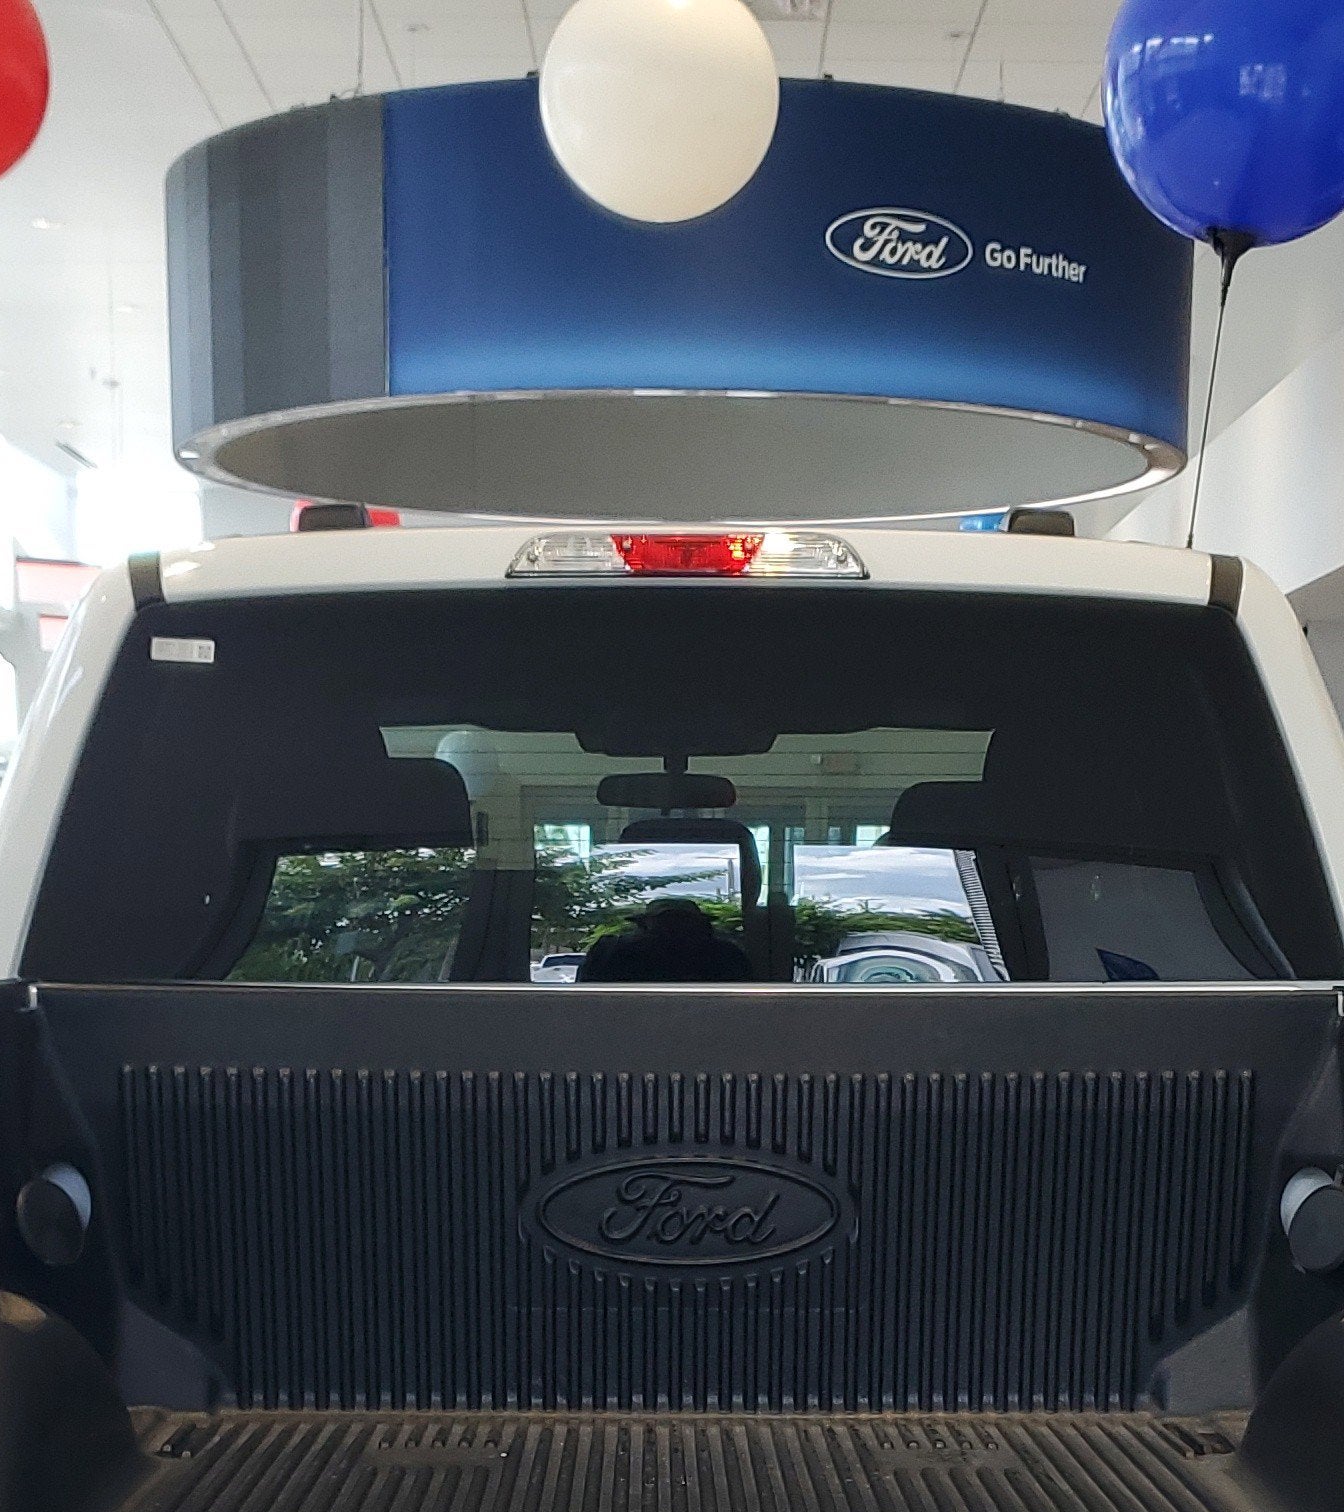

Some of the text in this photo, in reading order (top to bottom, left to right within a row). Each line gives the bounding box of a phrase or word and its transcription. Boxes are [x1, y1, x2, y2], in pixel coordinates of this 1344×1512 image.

[853, 215, 1087, 284] Ford Go Further
[601, 1171, 780, 1244] Ford
